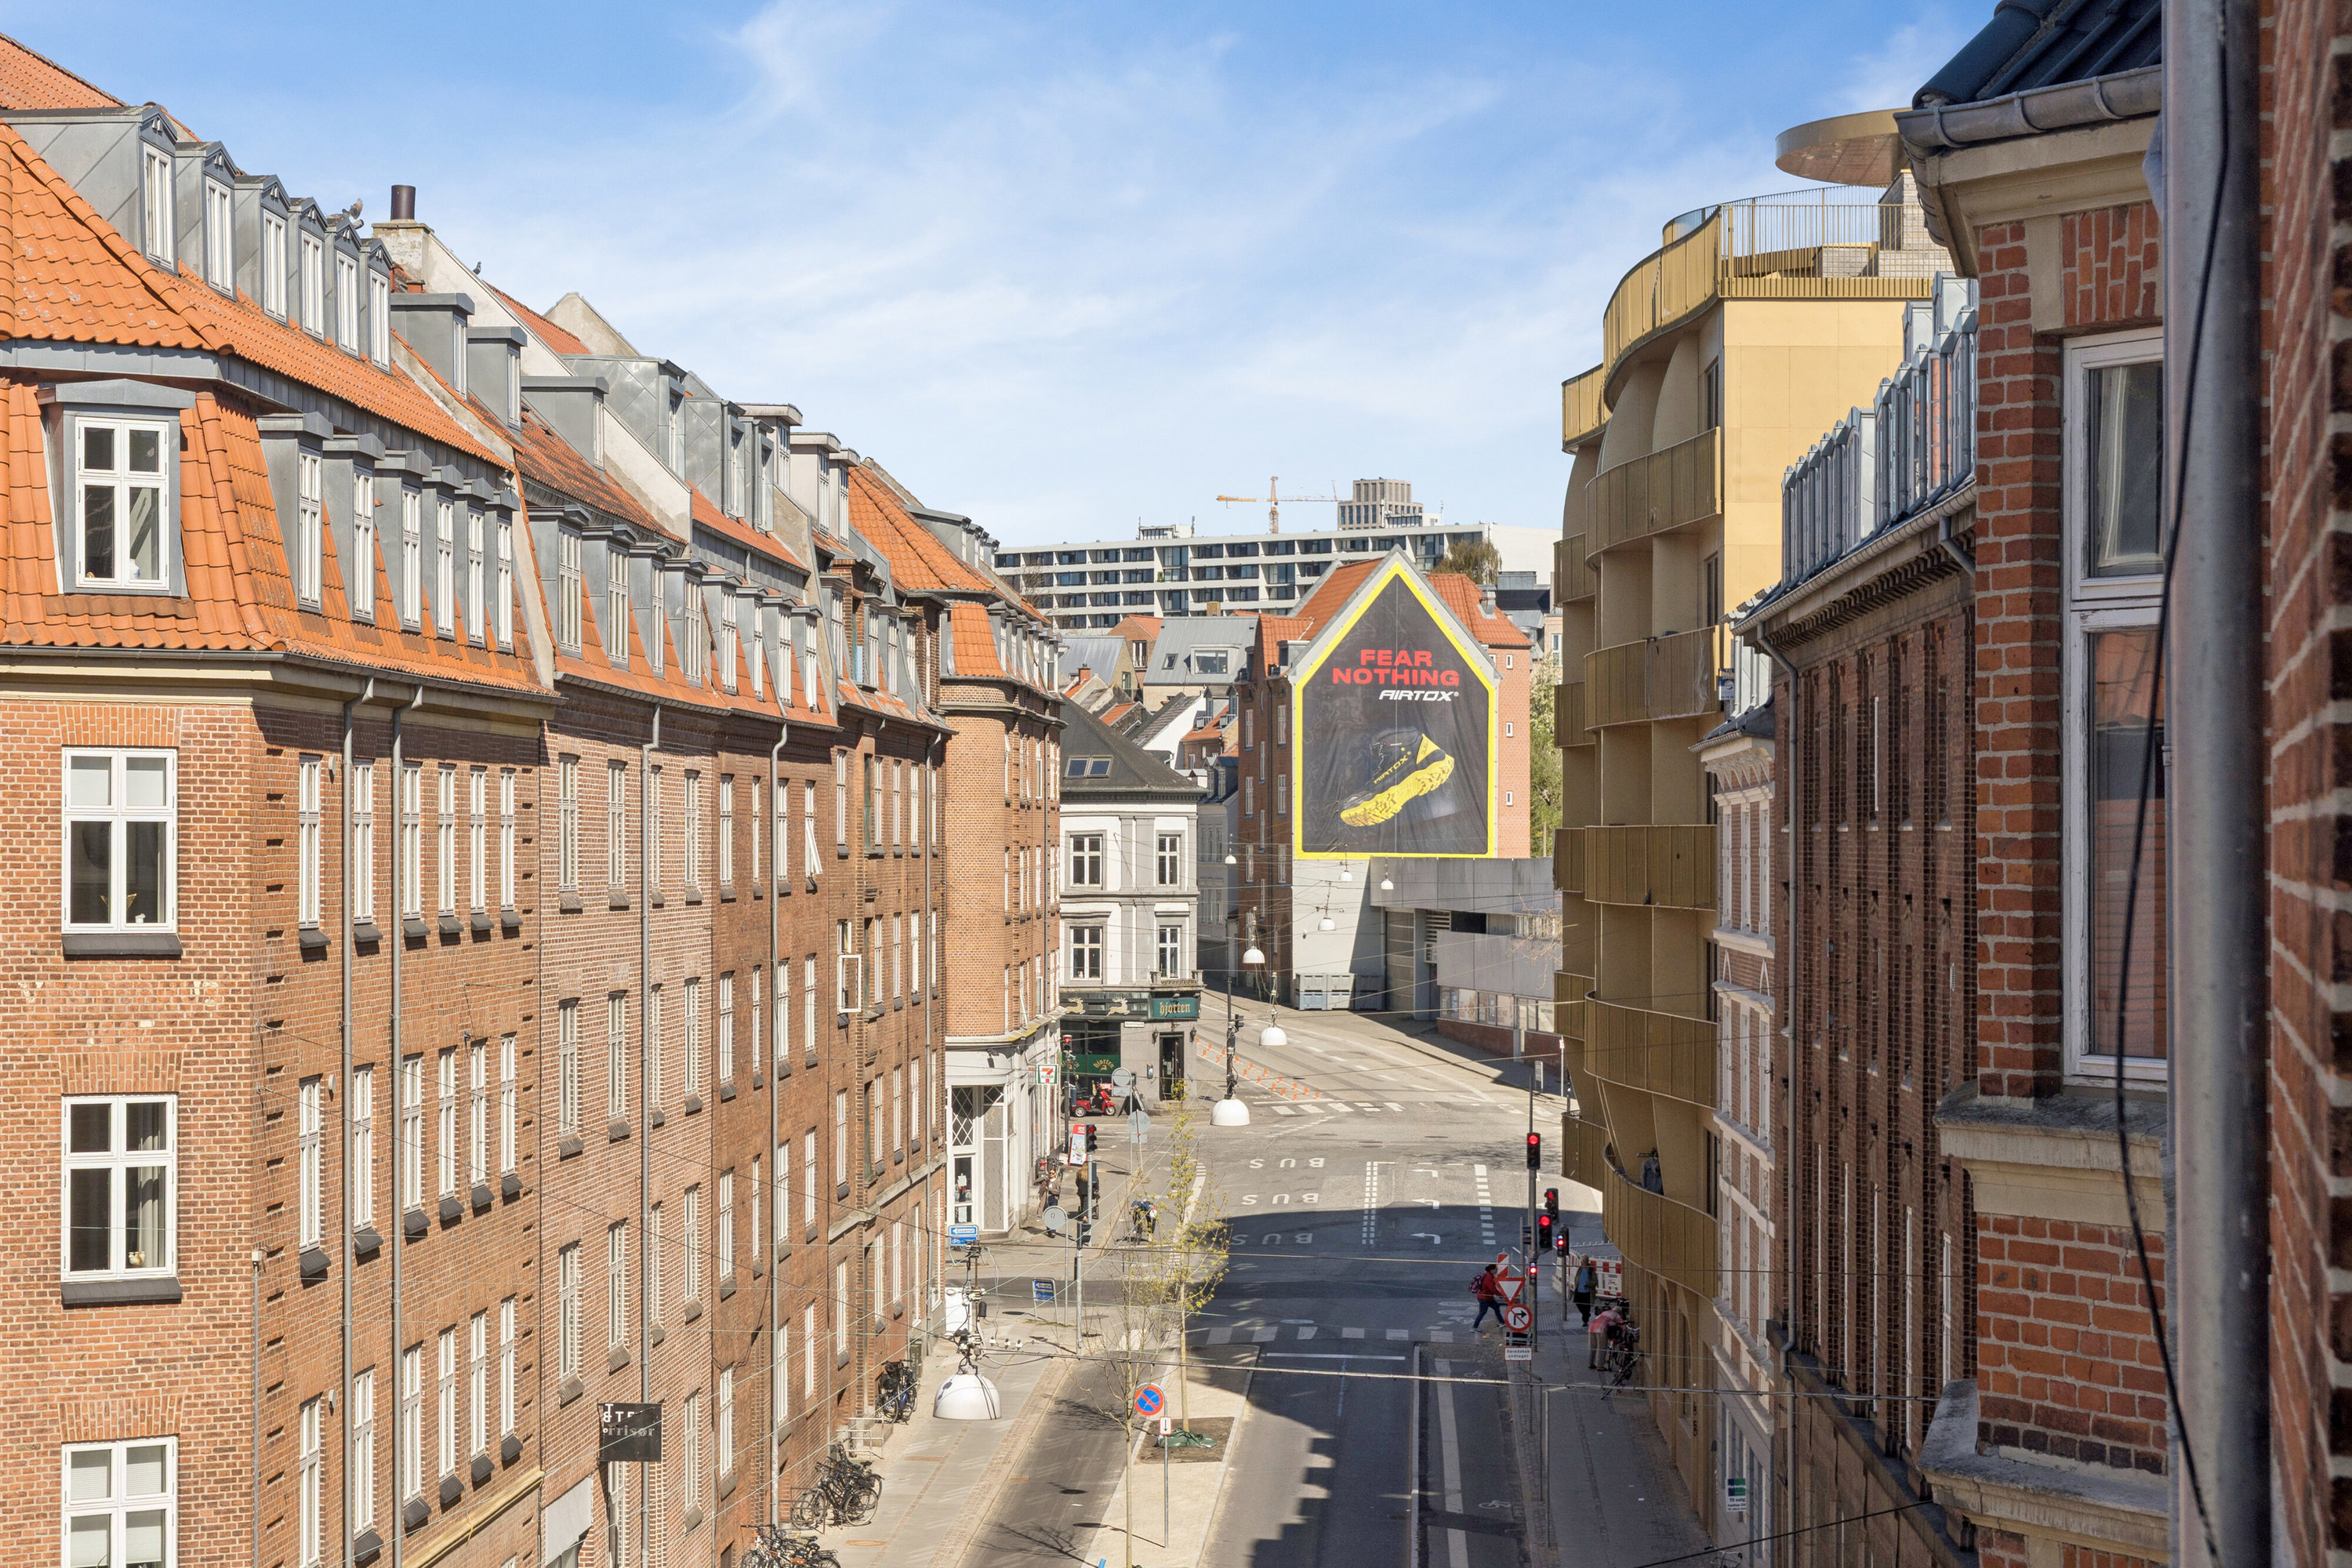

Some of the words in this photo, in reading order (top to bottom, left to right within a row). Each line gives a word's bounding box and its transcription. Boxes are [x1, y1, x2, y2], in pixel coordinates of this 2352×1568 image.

[1360, 649, 1432, 667] FEAR
[1333, 668, 1460, 687] NOTHING
[1160, 1001, 1191, 1015] hjorten
[1248, 1157, 1325, 1169] BUS
[1241, 1192, 1319, 1205] BUS
[1230, 1232, 1313, 1246] BUS
